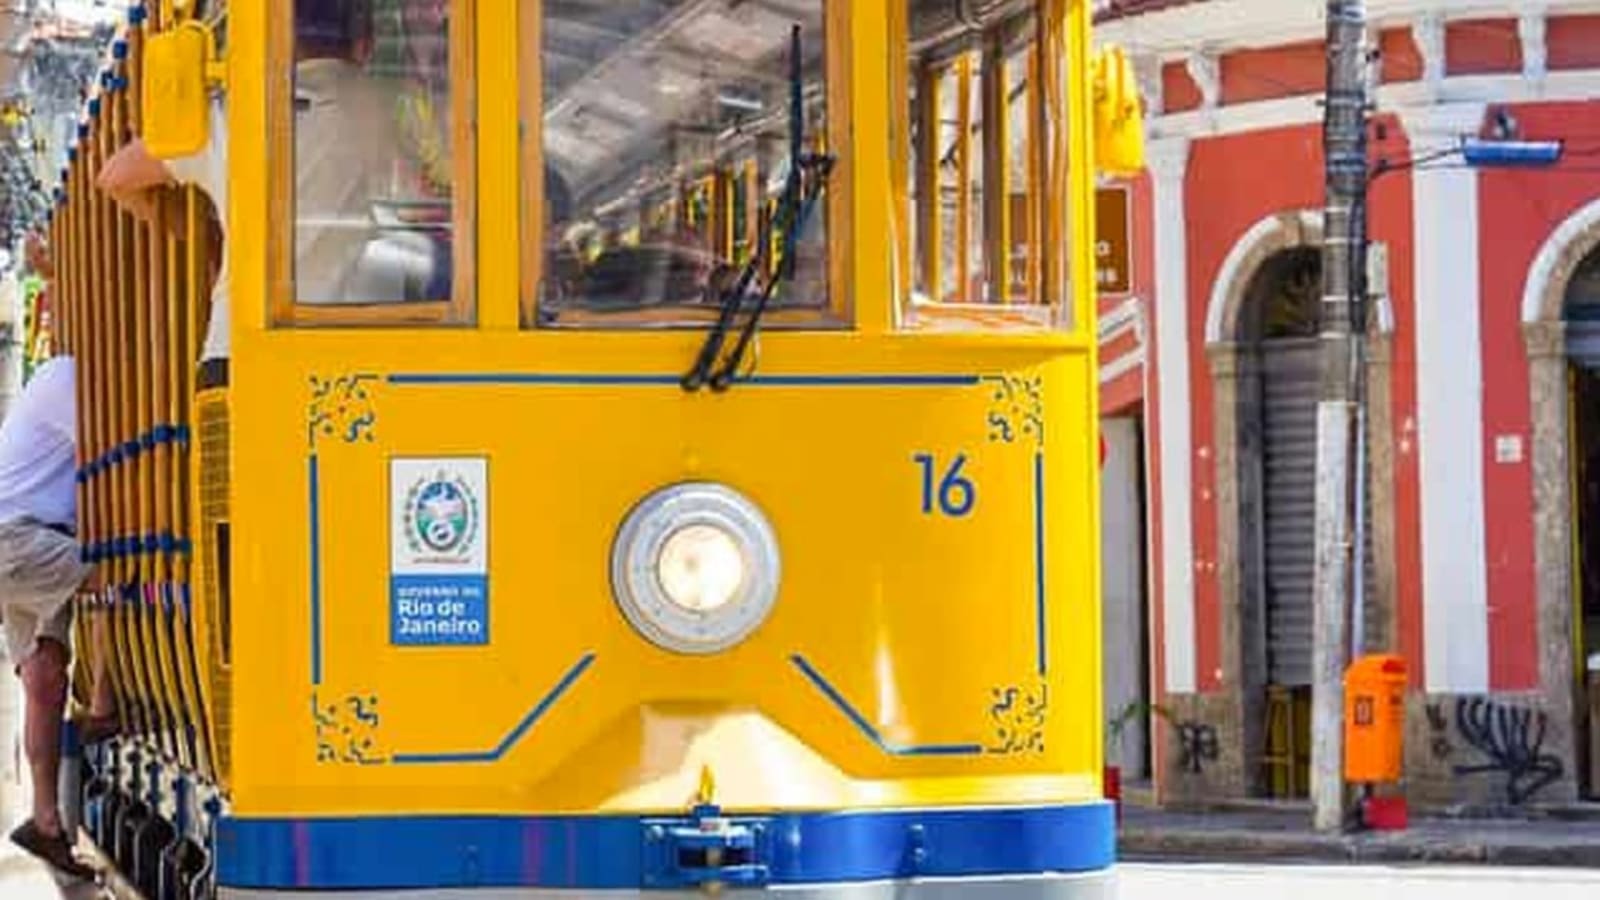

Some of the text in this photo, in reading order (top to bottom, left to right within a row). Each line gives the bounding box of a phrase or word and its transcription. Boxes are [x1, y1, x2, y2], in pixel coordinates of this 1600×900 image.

[913, 454, 975, 517] 16
[398, 598, 465, 616] Rio de
[399, 617, 480, 635] Janeiro
